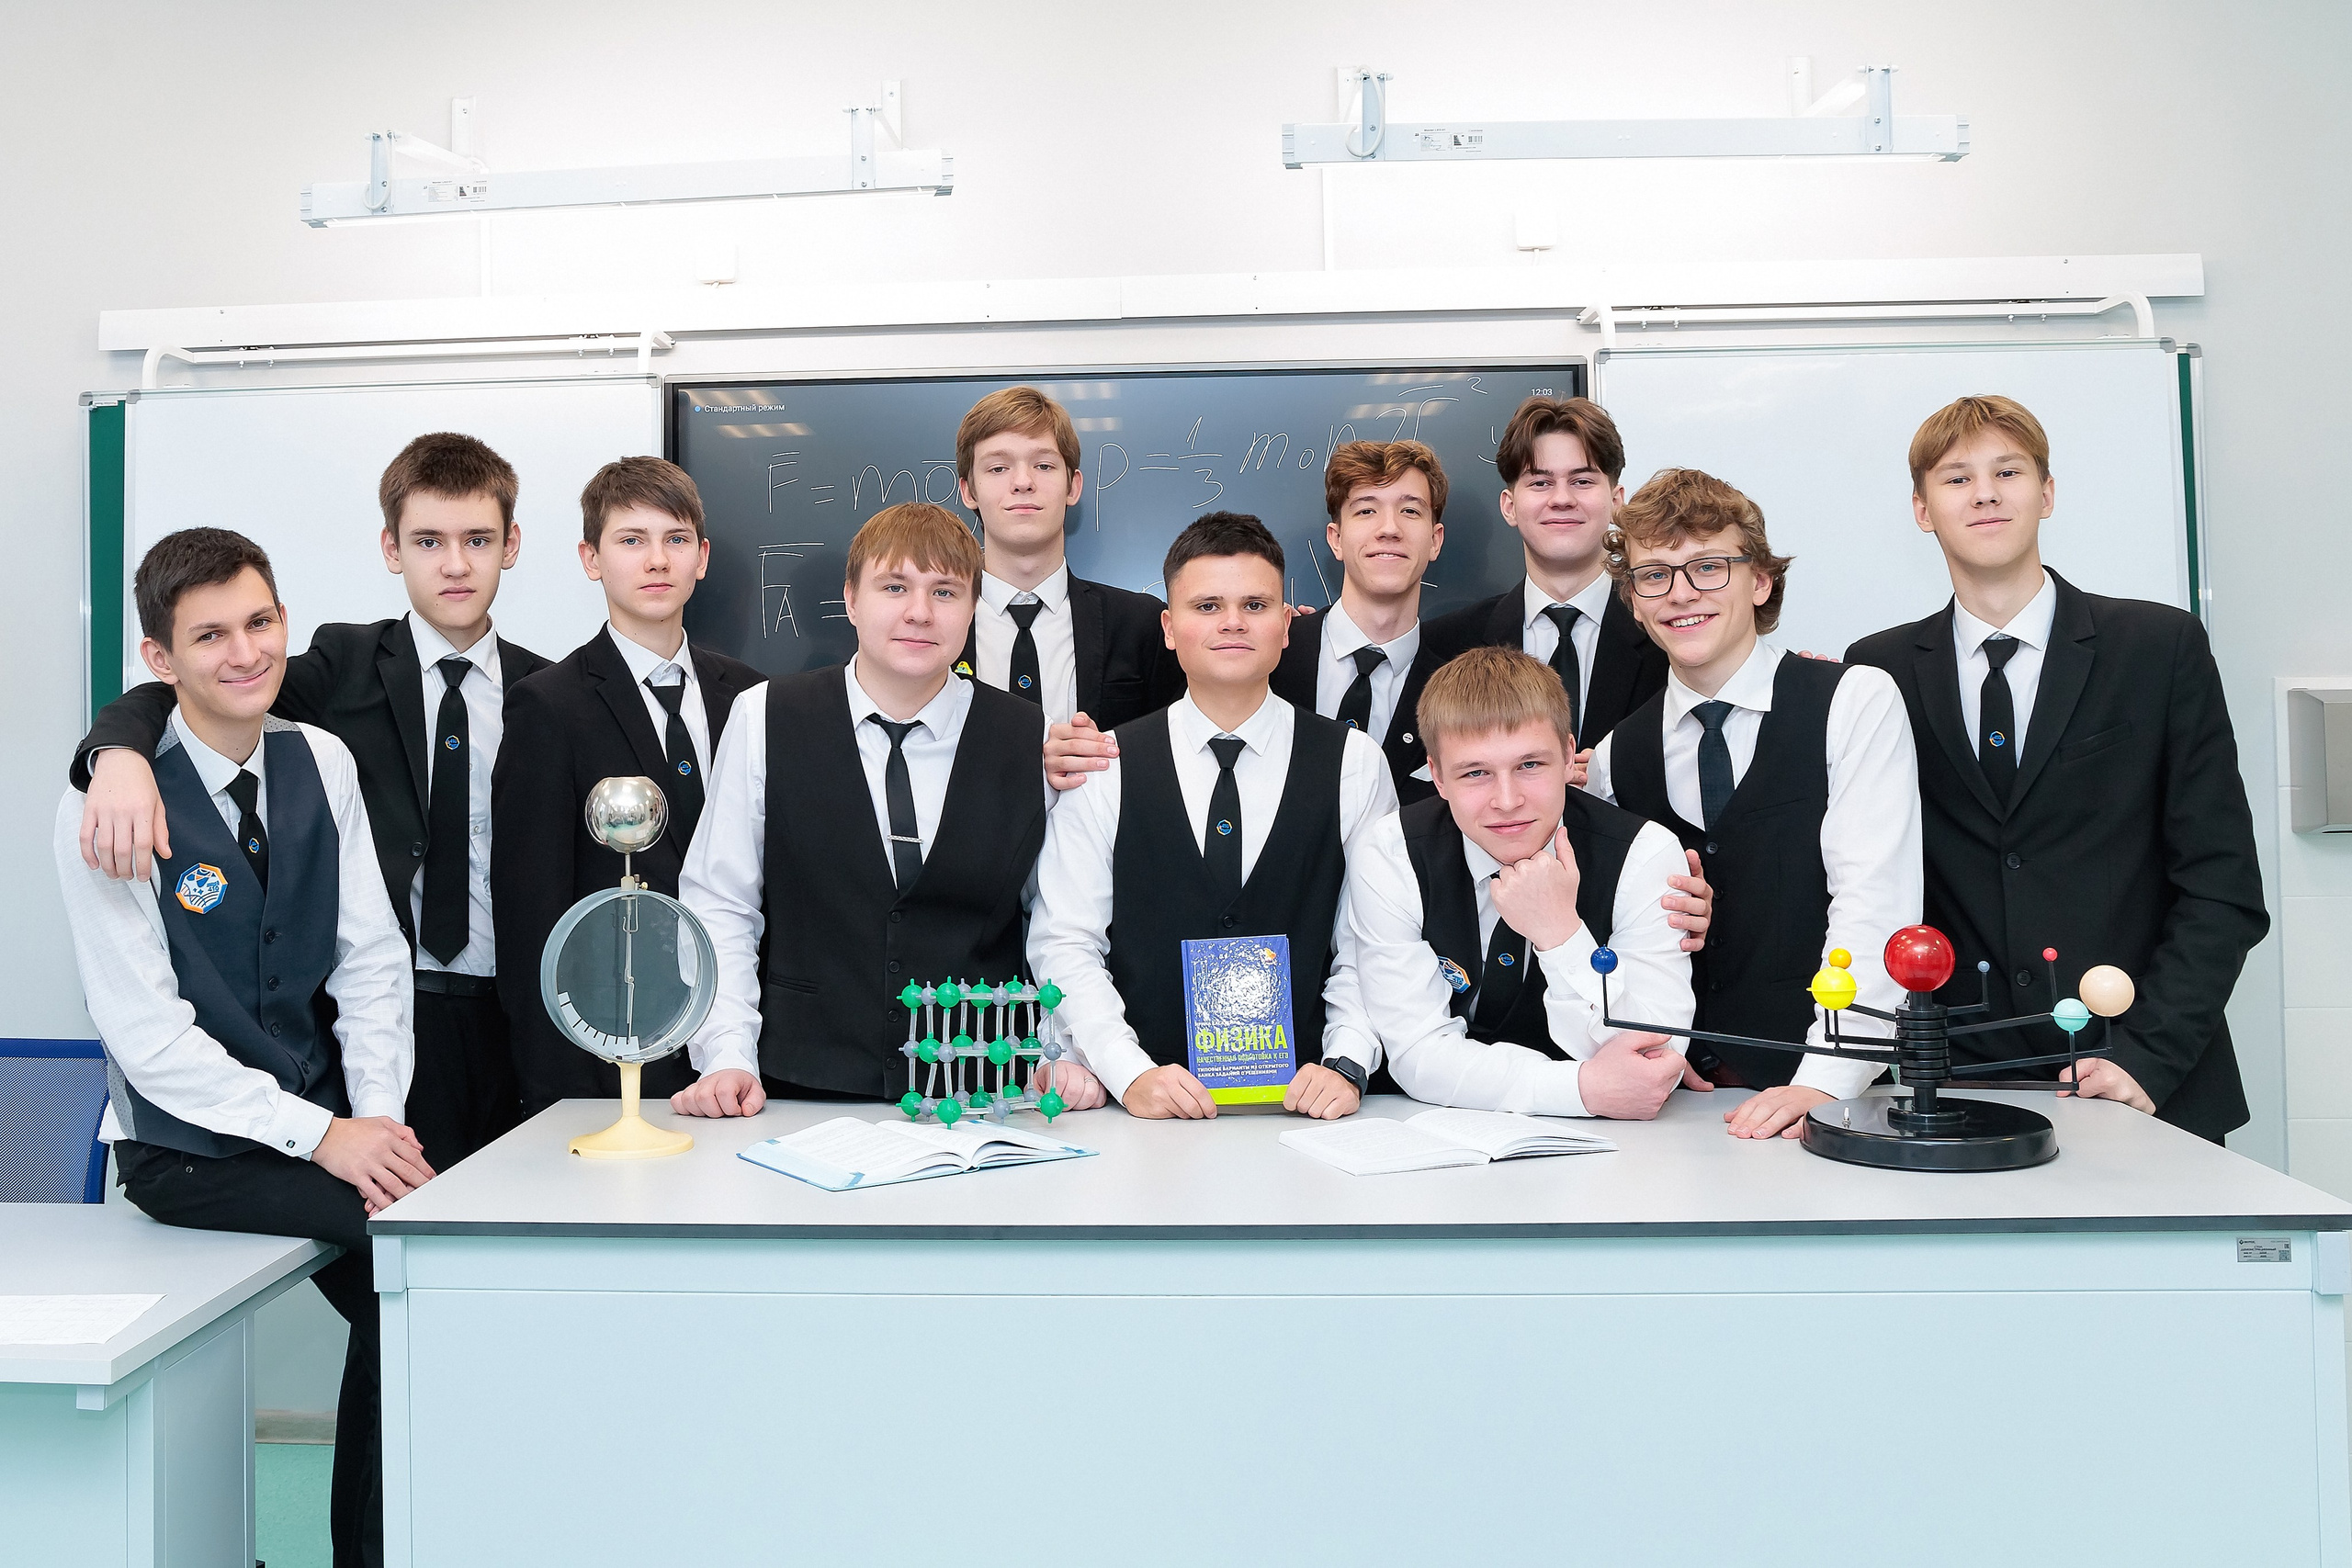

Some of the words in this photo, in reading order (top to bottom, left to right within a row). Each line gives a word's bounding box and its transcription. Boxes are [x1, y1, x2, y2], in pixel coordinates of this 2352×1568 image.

[1532, 388, 1553, 396] 12:03
[704, 403, 757, 413] Стандартный
[758, 404, 786, 412] режим
[1195, 1024, 1288, 1053] ФИЗИКА
